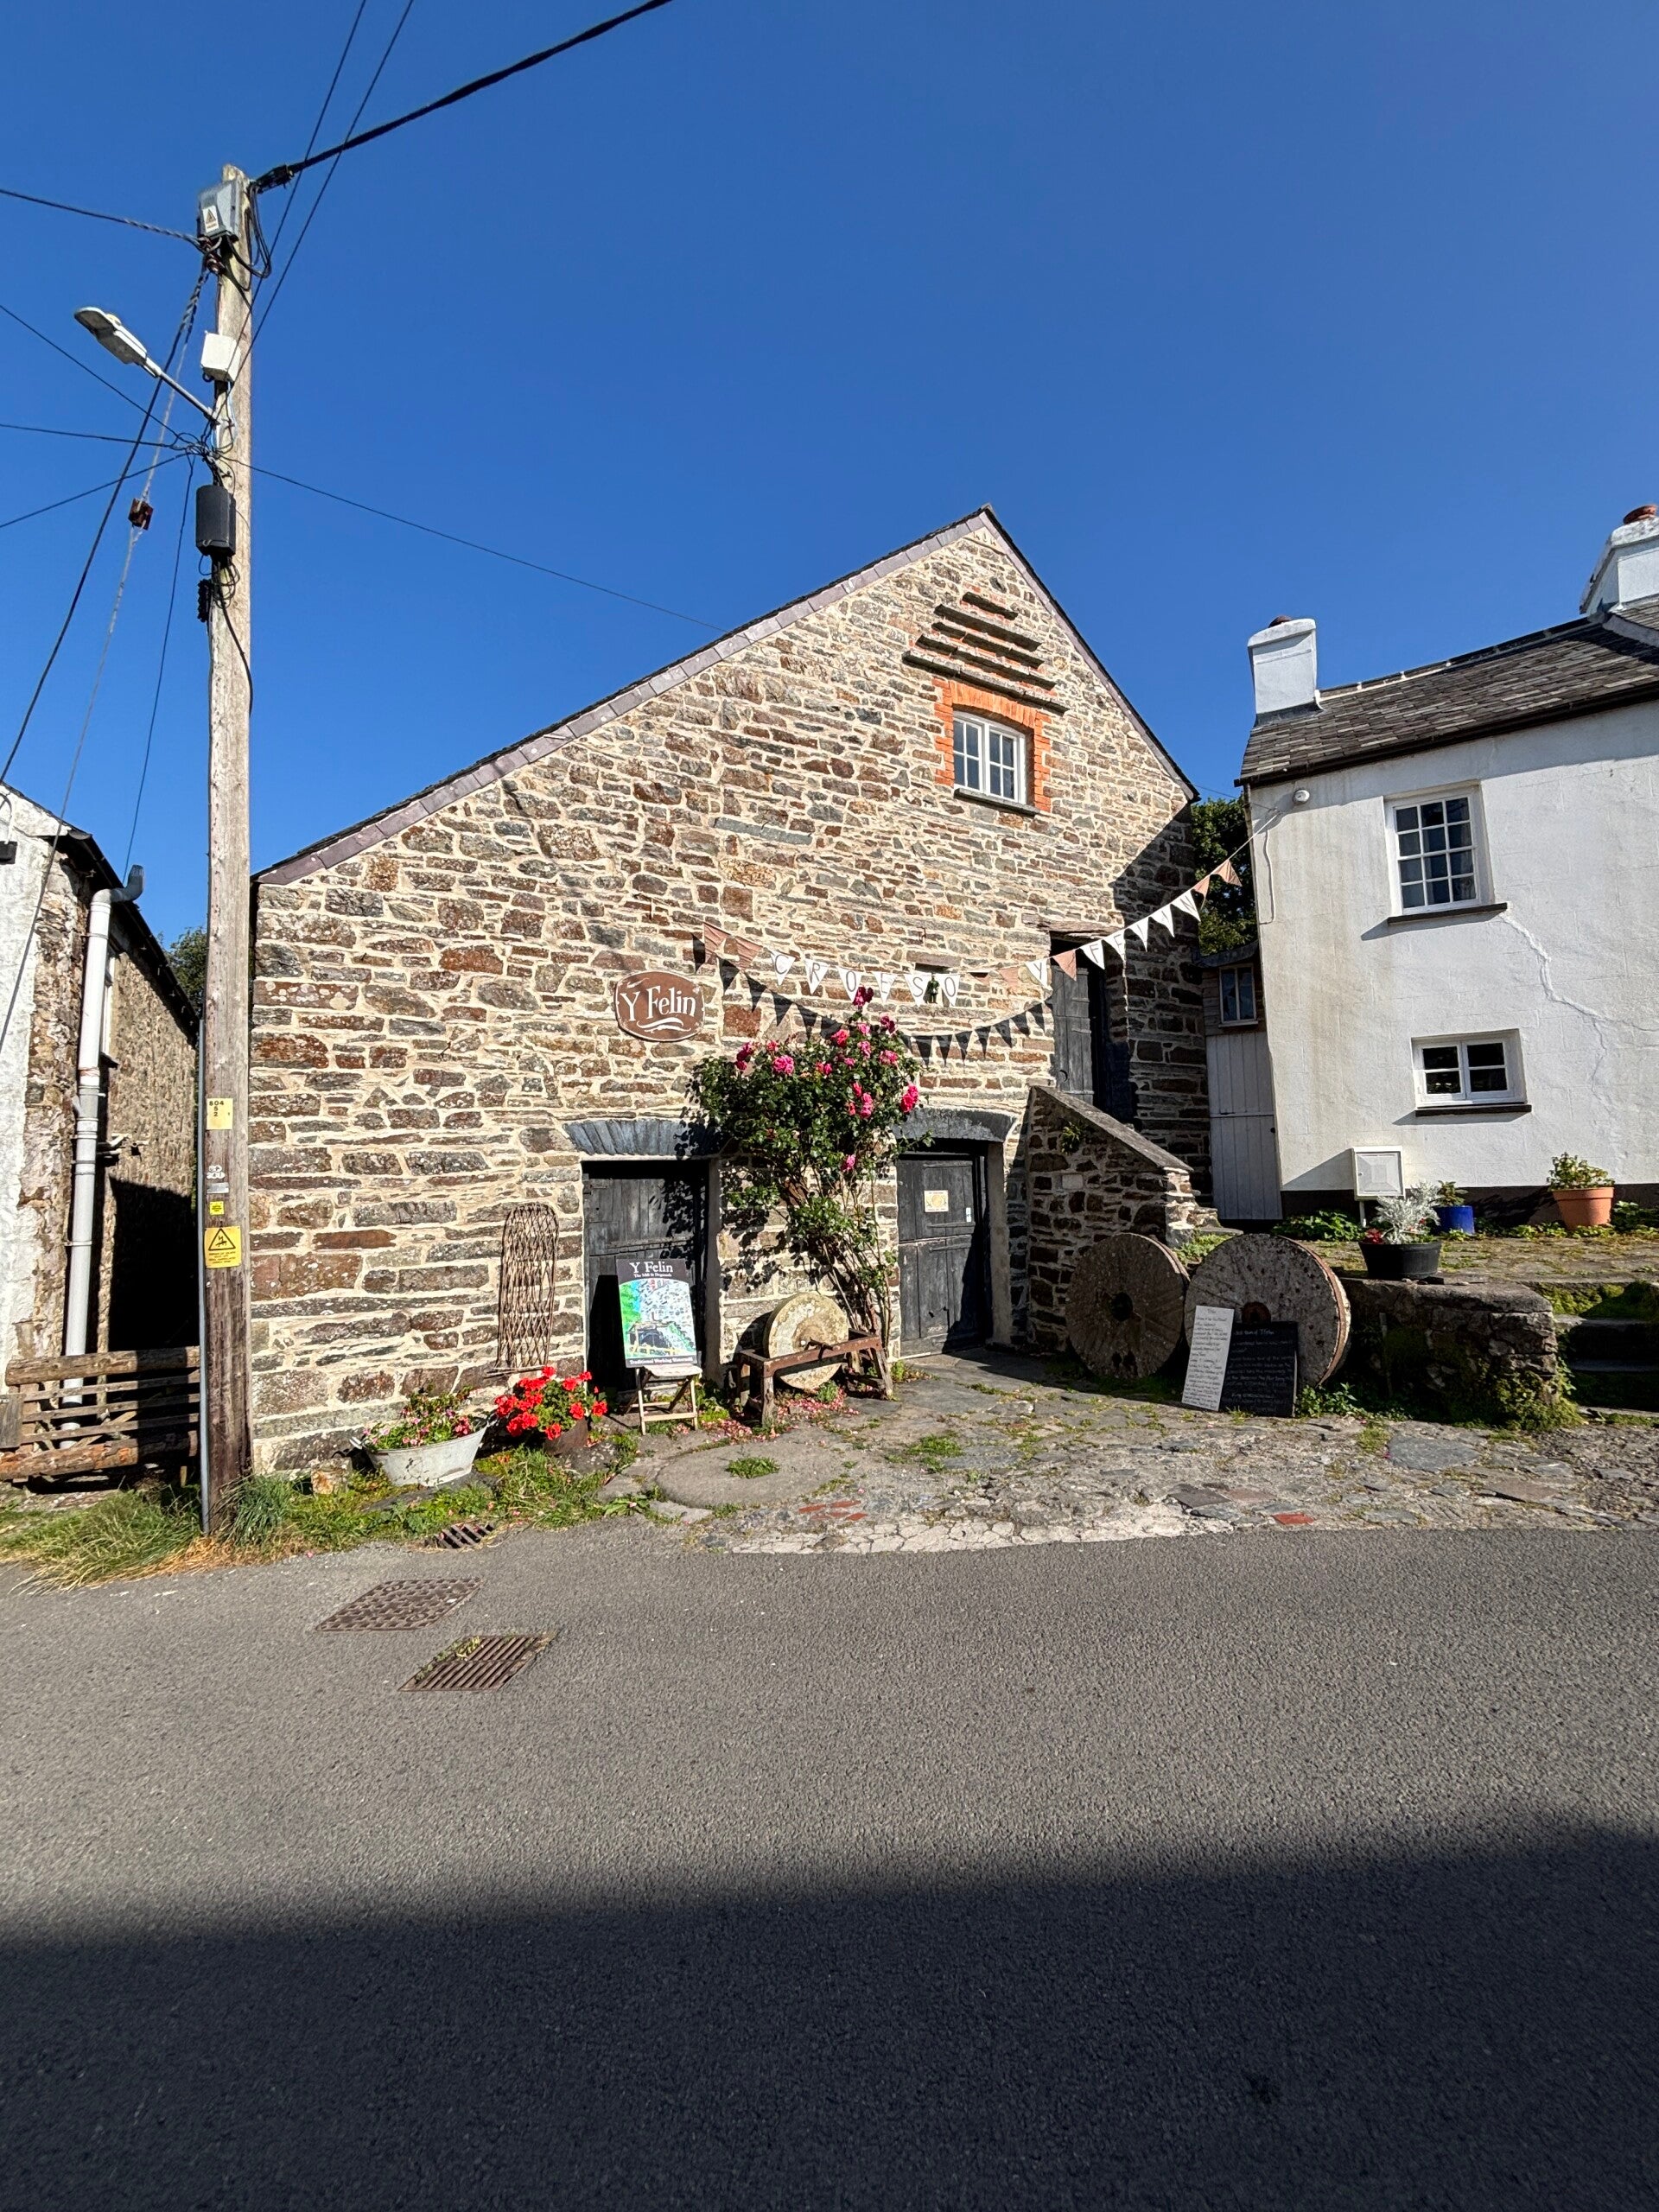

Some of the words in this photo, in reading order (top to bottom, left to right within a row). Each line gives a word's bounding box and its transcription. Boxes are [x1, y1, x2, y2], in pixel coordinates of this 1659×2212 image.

[774, 954, 957, 997] CROESO
[1033, 962, 1043, 981] Y
[620, 990, 641, 1022] Y
[645, 985, 696, 1020] Felin
[629, 1262, 640, 1274] Y
[644, 1261, 673, 1273] Felin
